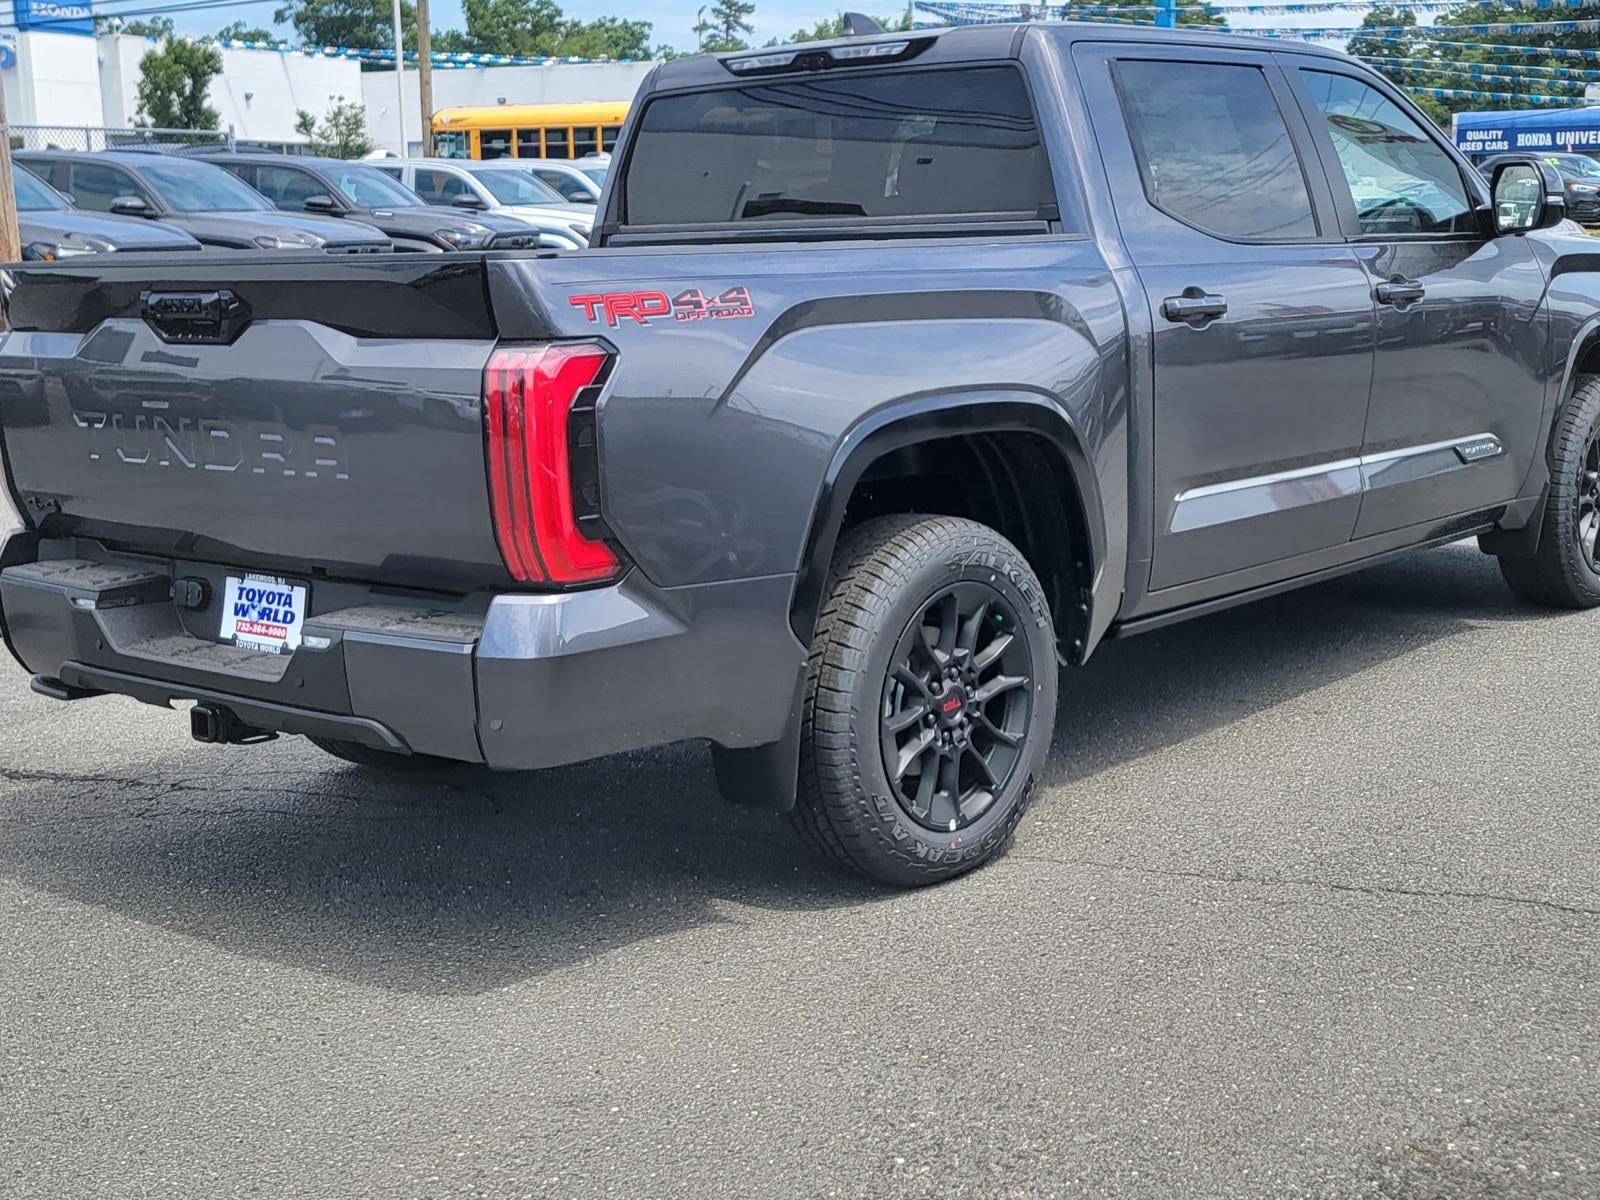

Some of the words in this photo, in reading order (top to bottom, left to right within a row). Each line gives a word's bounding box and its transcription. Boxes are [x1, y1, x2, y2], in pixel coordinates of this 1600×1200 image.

[31, 1, 92, 18] HONDA
[1466, 130, 1503, 140] QUALITY
[1516, 133, 1552, 147] HONDA
[1556, 130, 1600, 145] UNIVE
[1460, 141, 1483, 151] USED
[1484, 140, 1509, 151] CARS
[568, 290, 674, 329] TRD
[674, 309, 709, 323] OFF
[710, 306, 755, 320] ROAD
[72, 410, 350, 481] TUNDRA
[237, 586, 293, 609] TOYOTA
[235, 640, 259, 651] TOYOTA
